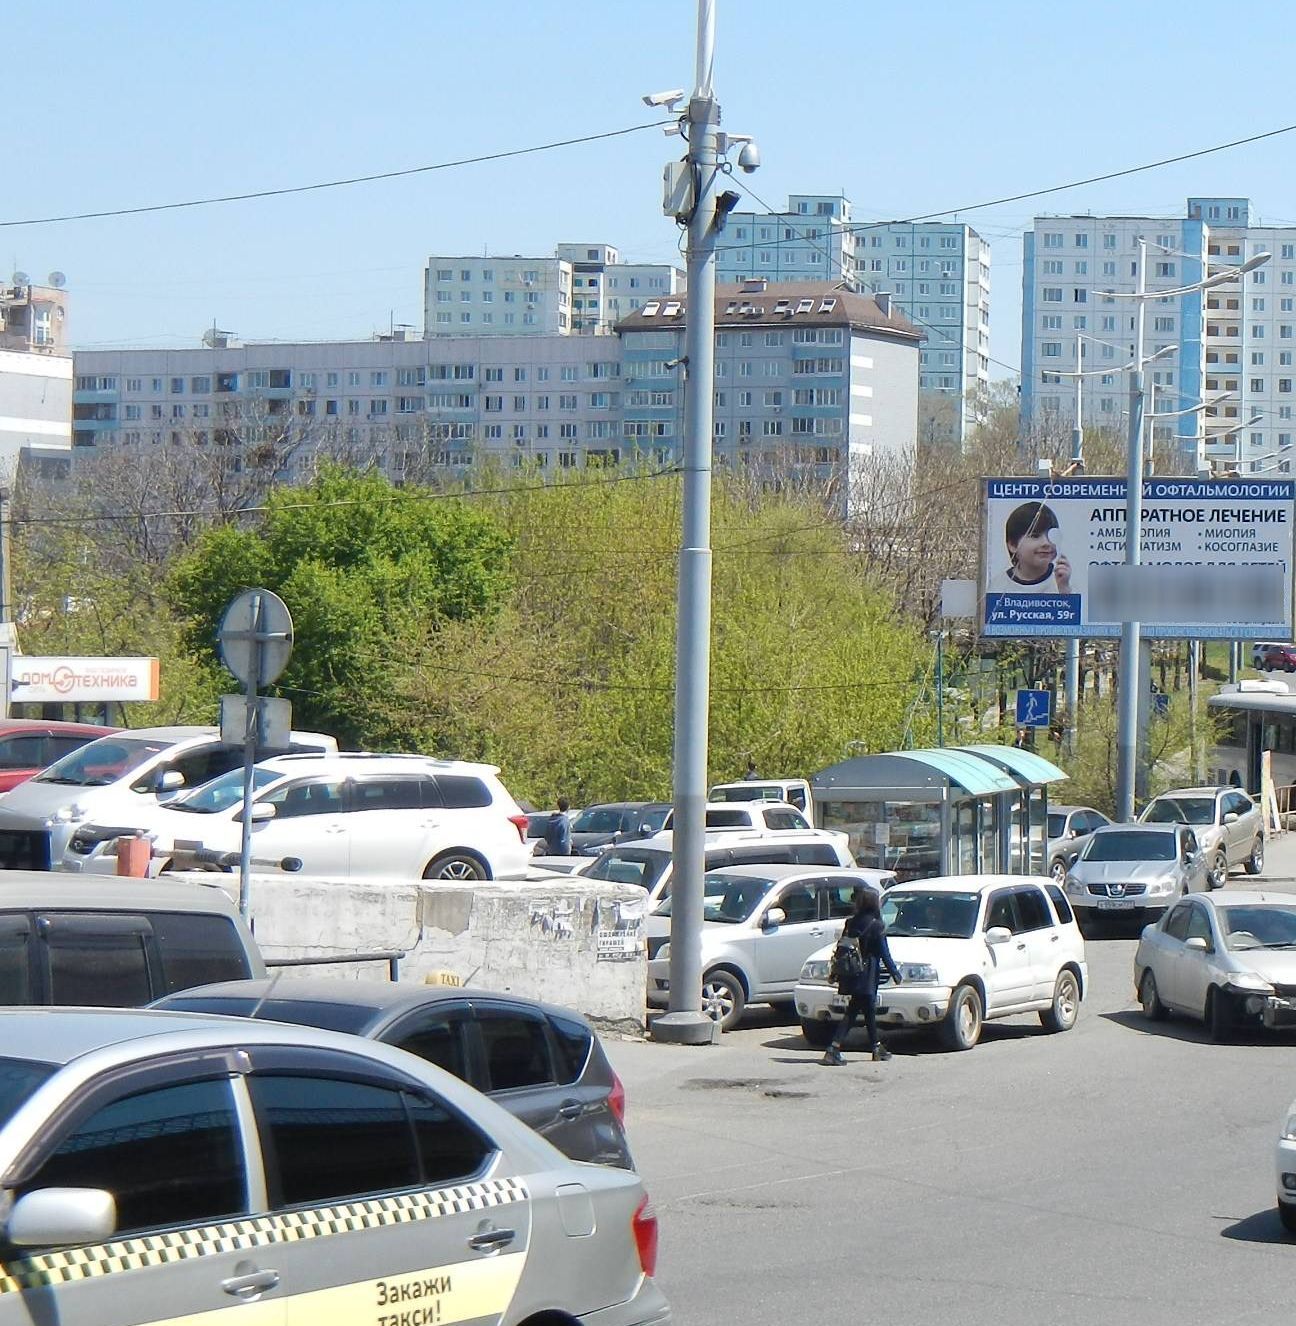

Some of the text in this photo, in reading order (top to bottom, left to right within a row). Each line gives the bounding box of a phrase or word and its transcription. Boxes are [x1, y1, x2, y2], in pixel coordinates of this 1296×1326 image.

[993, 483, 1290, 498] ЦЕНТР СОВРЕМЕННЙ ОФТАЛЬМОЛОГИИ
[1090, 508, 1287, 523] АППРАТНОЕ ЛЕЧЕНИЕ
[1096, 528, 1171, 538] АМБЛОПИЯ
[1204, 528, 1256, 538] МИОПИЯ
[1204, 542, 1279, 552] КОСОГЛАЗИЕ
[1009, 609, 1055, 621] Русская,
[440, 973, 460, 987] TAXI
[376, 1275, 452, 1306] Закажи
